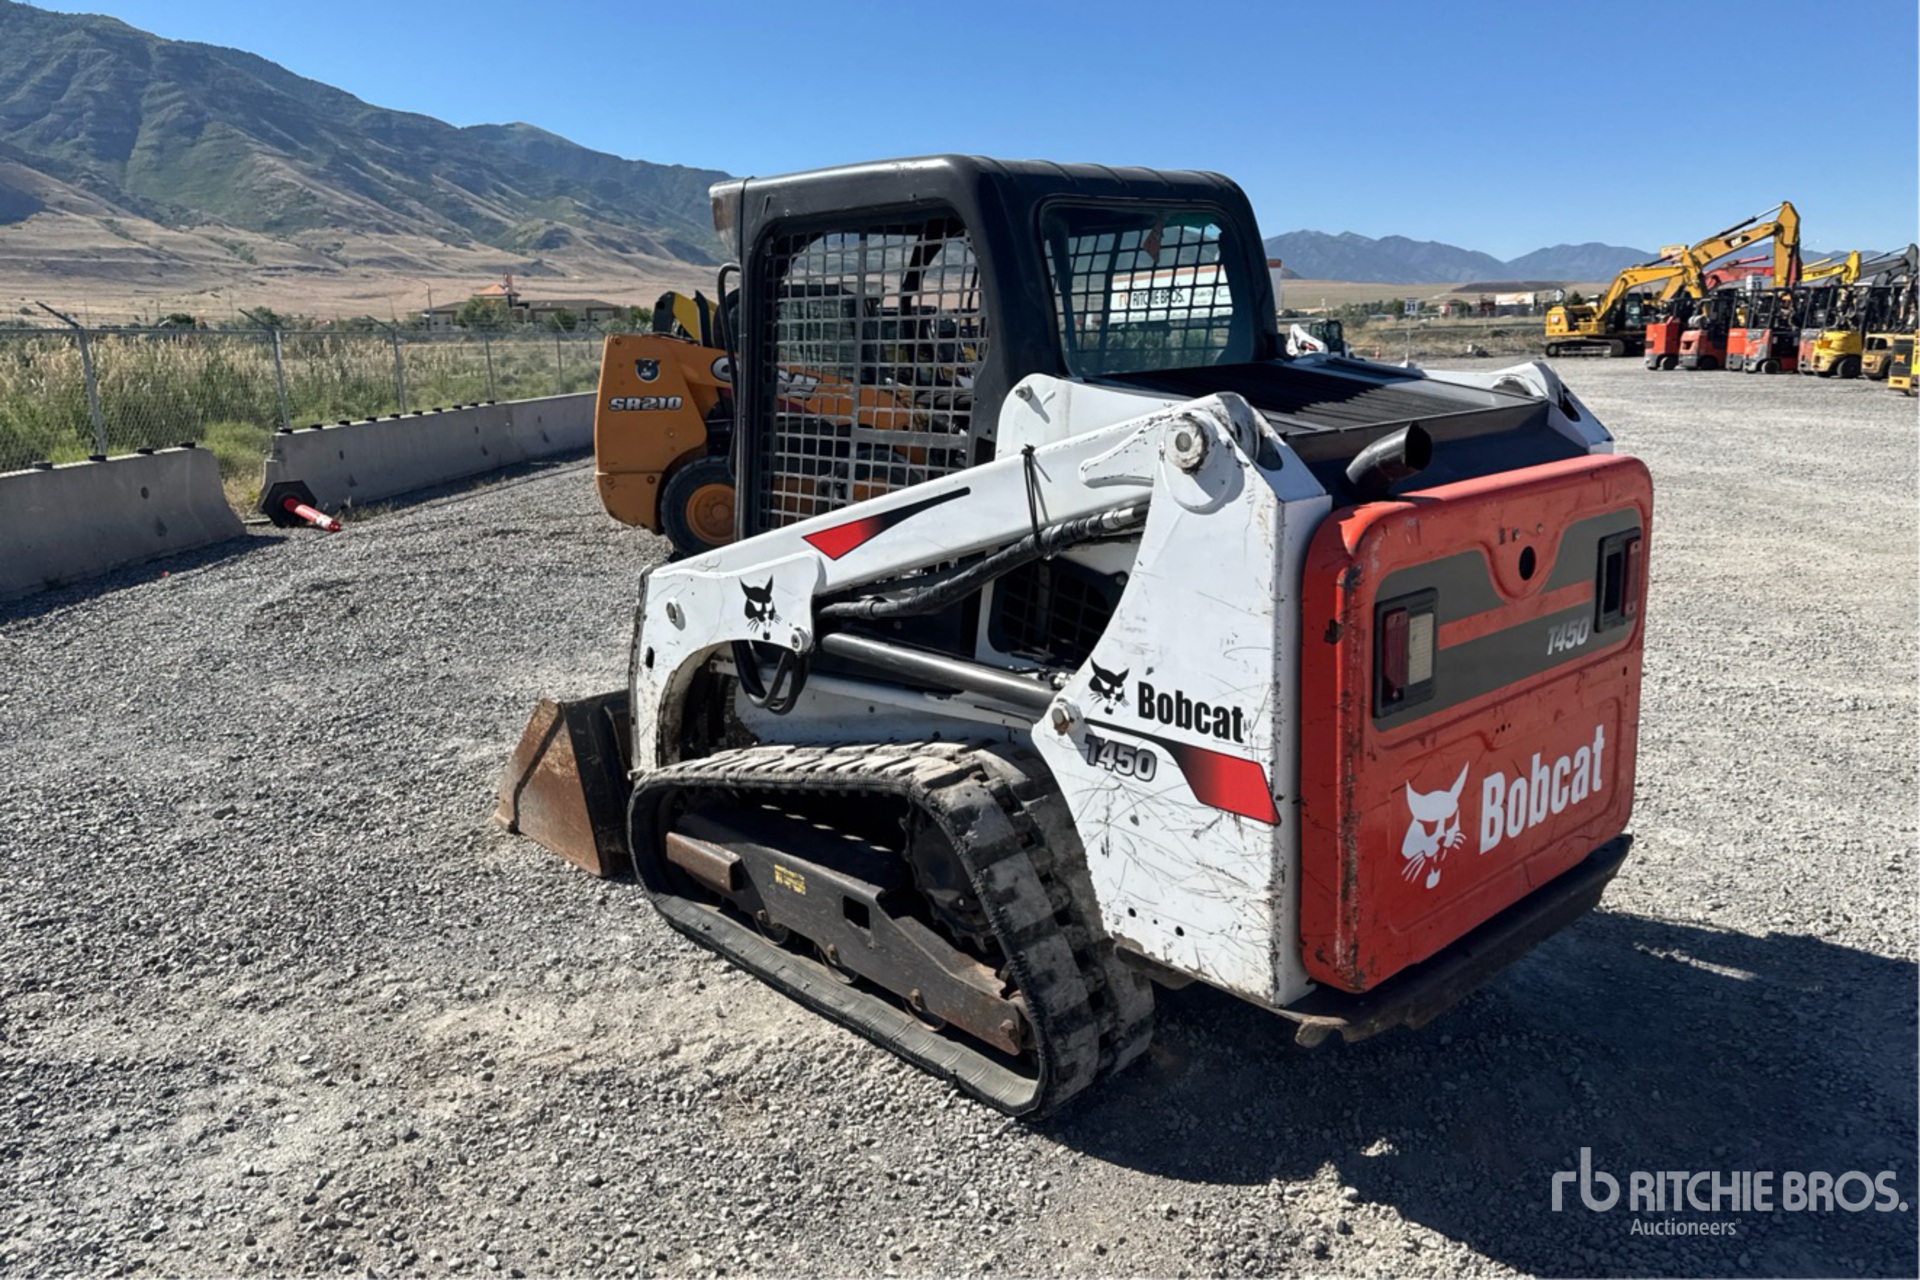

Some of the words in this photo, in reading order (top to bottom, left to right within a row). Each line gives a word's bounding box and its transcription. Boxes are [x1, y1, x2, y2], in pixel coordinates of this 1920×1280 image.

[609, 396, 683, 413] SR210
[1546, 616, 1591, 656] T450
[1138, 681, 1244, 744] Bobcat
[1084, 733, 1158, 783] T450
[1480, 724, 1606, 855] Bobcat
